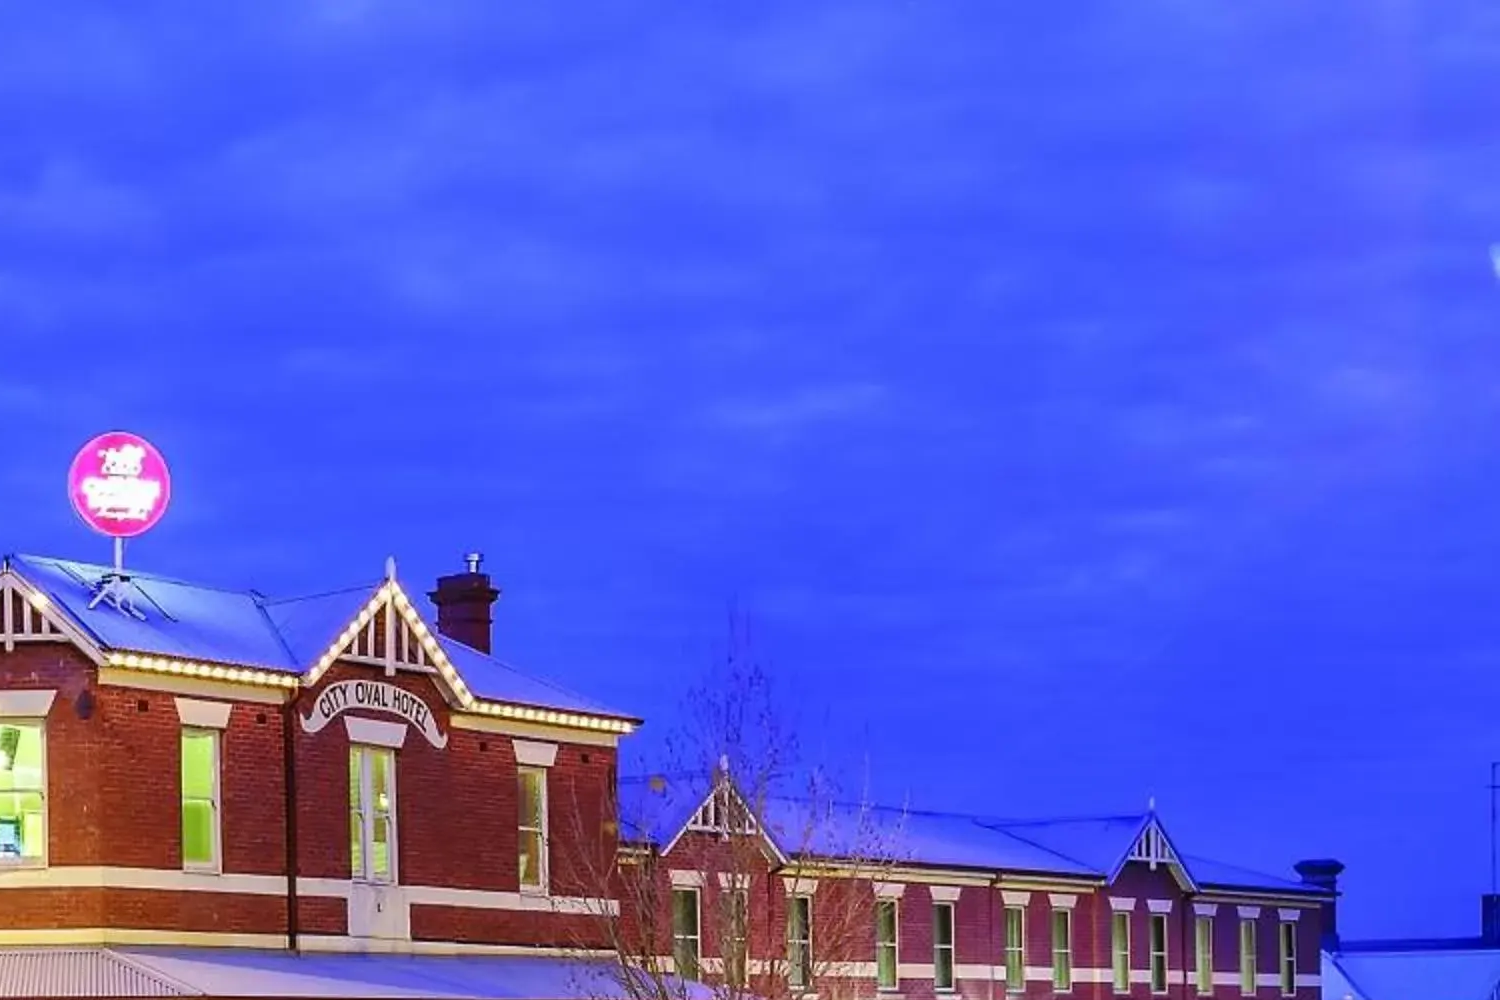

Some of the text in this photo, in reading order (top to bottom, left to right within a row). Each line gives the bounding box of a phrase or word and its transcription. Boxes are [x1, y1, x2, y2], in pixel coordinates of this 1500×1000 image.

[320, 682, 430, 733] CITY OVAL HOTEL
